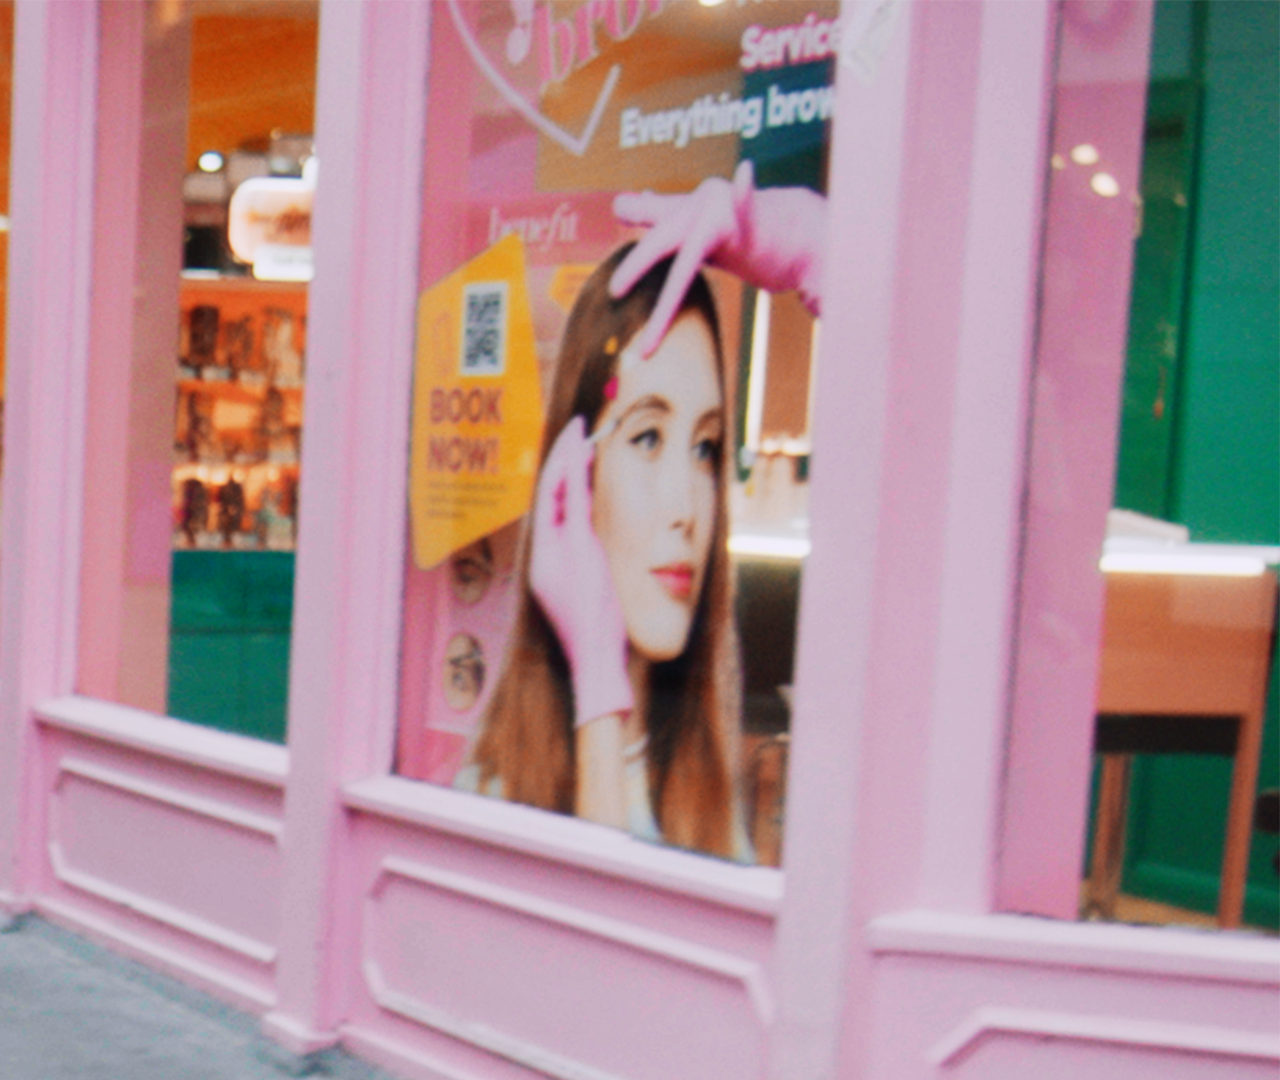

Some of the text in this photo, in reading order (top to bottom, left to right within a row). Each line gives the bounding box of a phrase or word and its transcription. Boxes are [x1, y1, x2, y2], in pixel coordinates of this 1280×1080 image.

[619, 93, 763, 149] Everything
[429, 386, 503, 424] BOOK
[427, 434, 500, 474] NOW!
